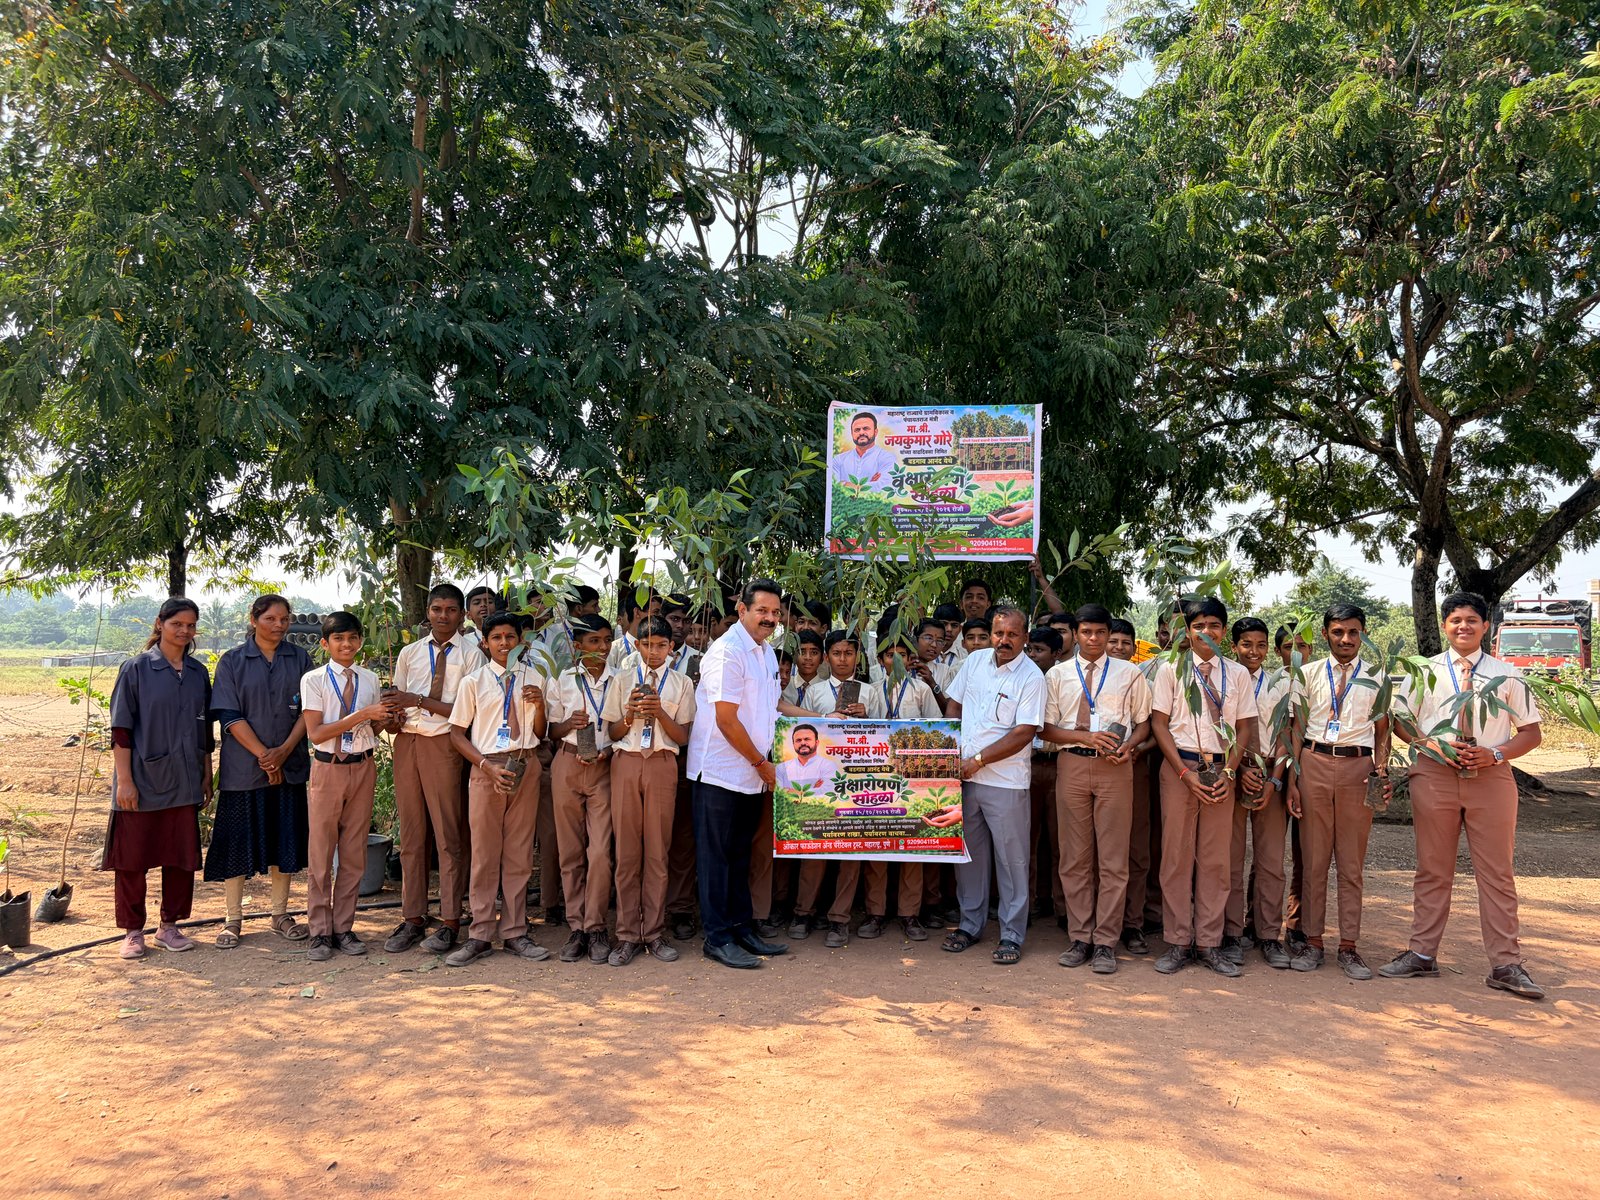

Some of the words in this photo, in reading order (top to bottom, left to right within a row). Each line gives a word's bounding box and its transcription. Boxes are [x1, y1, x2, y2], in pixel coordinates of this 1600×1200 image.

[885, 434, 932, 449] जयकुमार
[933, 430, 953, 447] गोरे
[826, 745, 870, 758] जयकुमार
[871, 742, 889, 757] गोरे
[834, 774, 901, 801] वृक्षारोपण
[851, 790, 895, 807] सोहळा
